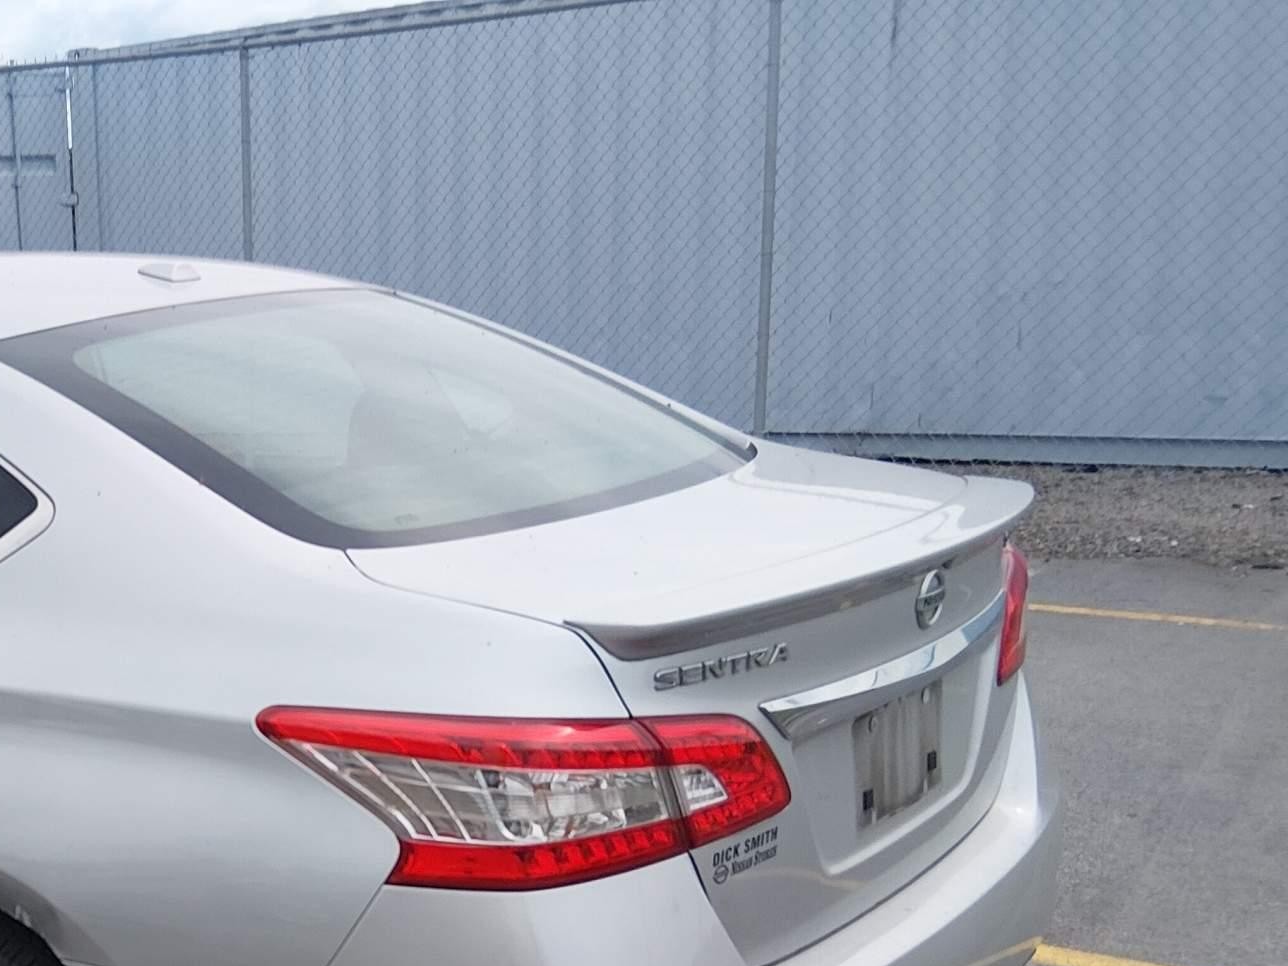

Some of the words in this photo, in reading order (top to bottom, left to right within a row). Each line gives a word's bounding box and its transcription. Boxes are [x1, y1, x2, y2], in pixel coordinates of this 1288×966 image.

[654, 643, 789, 691] SENTRA
[713, 843, 741, 867] DICK
[744, 826, 778, 853] SMITH
